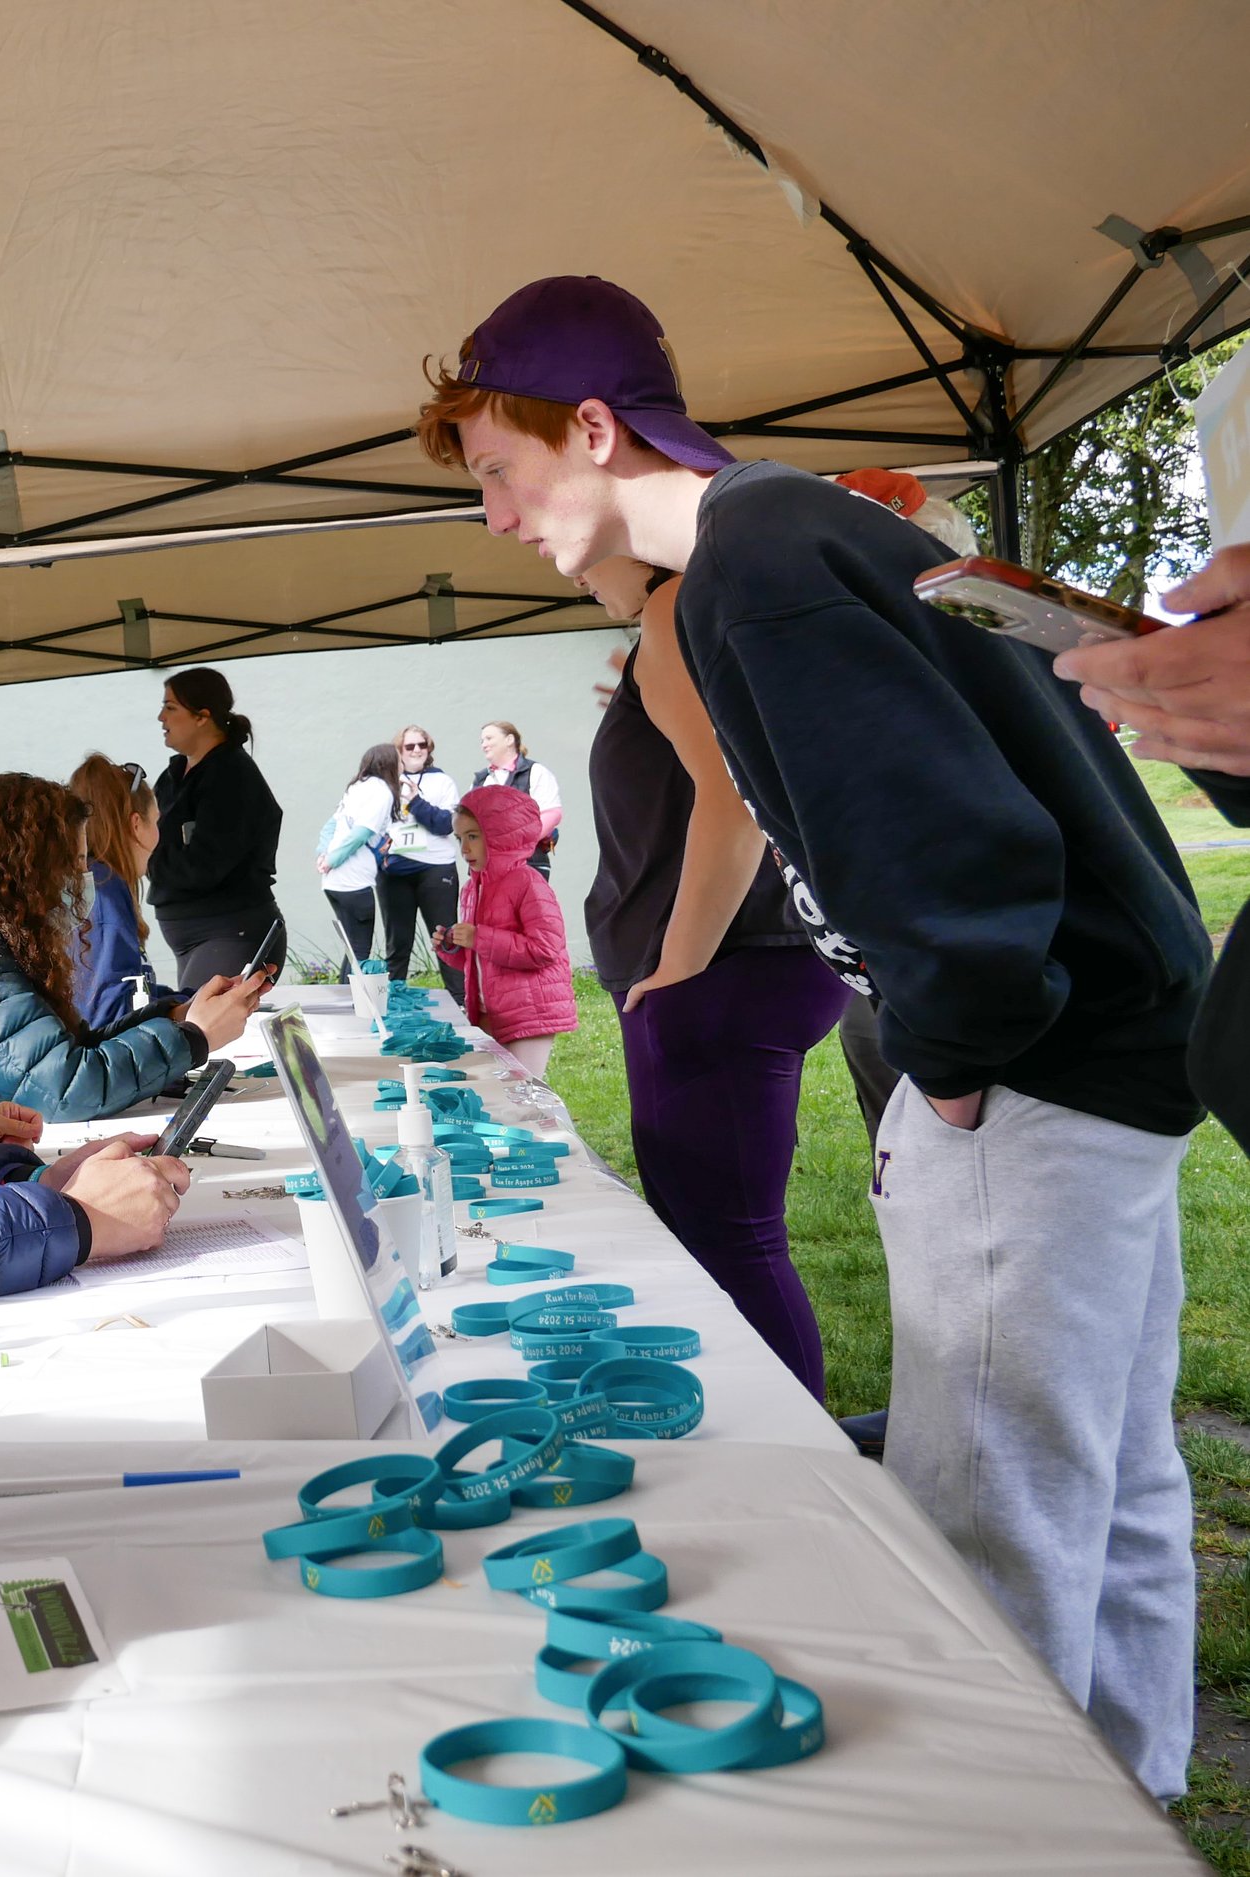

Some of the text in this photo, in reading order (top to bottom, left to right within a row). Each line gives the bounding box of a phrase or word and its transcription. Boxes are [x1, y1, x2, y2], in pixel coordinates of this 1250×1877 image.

[402, 832, 415, 845] 77
[299, 1177, 310, 1188] 5k
[514, 1177, 534, 1187] Agape
[544, 1293, 563, 1304] Run
[565, 1291, 577, 1301] for
[538, 1314, 560, 1325] 2024
[564, 1315, 575, 1325] 5k
[546, 1345, 557, 1356] 5k
[558, 1344, 584, 1356] 2024
[638, 1349, 650, 1358] 5k
[653, 1347, 680, 1358] Agape
[560, 1411, 575, 1425] 5k
[633, 1410, 665, 1422] Agape
[509, 1457, 544, 1482] Agape
[493, 1475, 510, 1491] 5k
[461, 1482, 492, 1500] 2024
